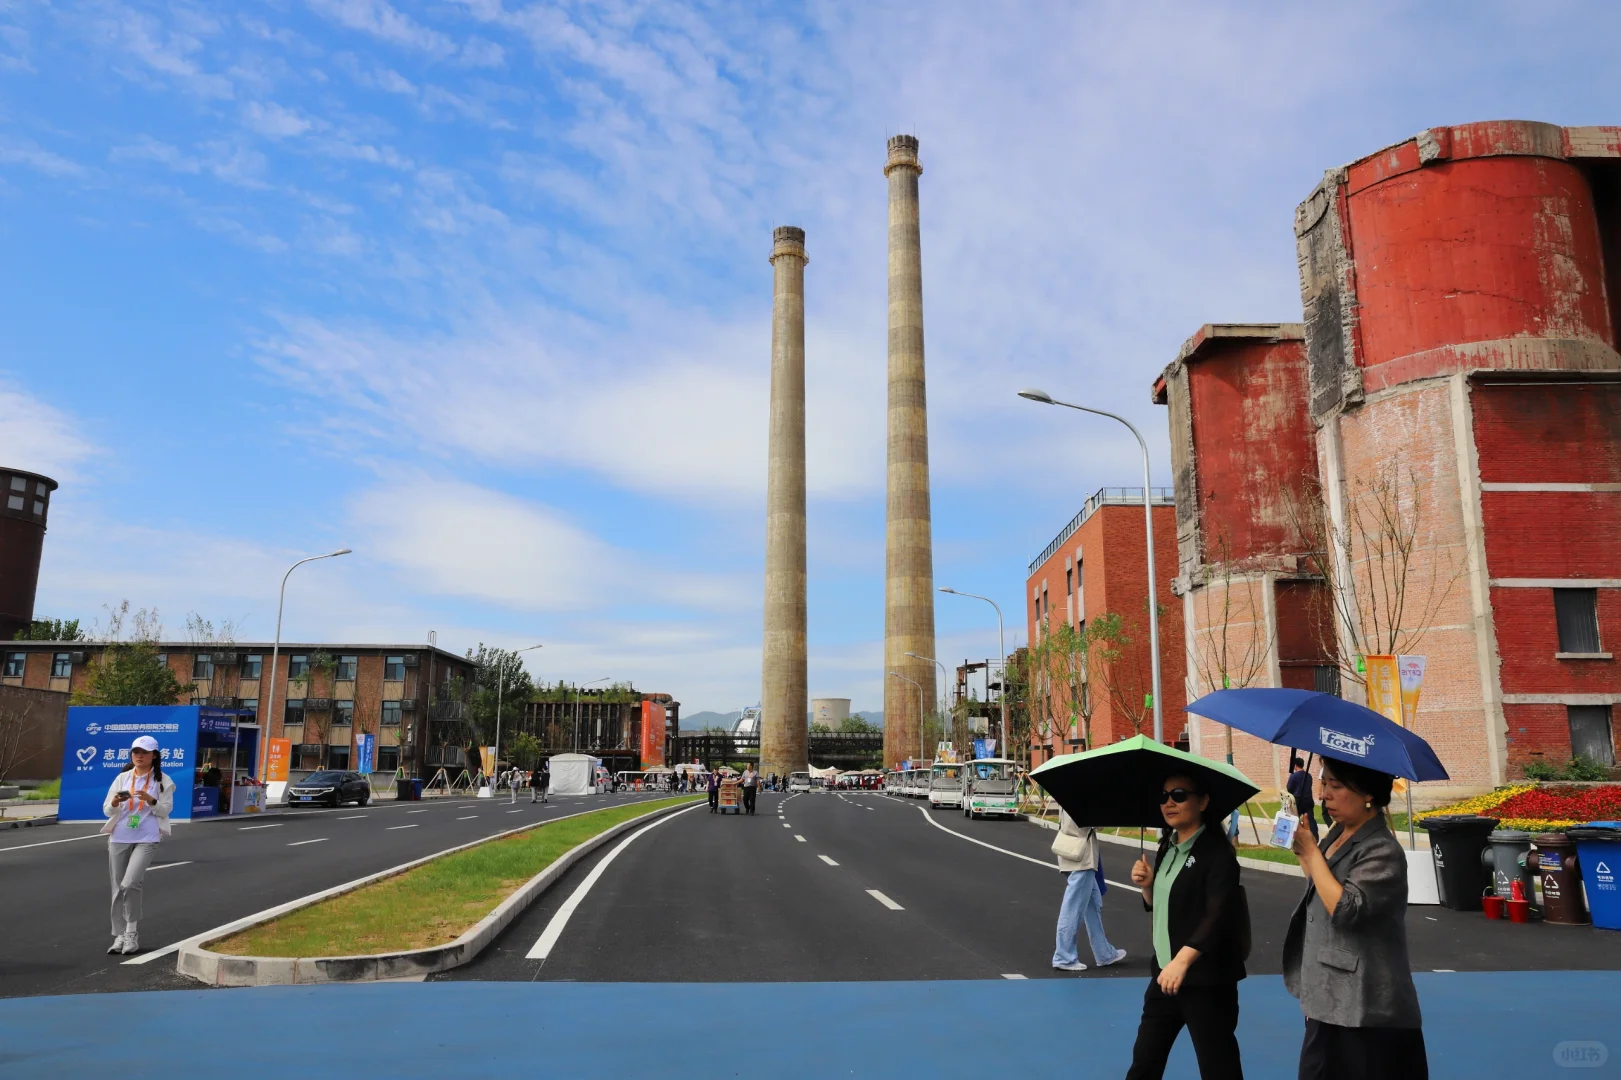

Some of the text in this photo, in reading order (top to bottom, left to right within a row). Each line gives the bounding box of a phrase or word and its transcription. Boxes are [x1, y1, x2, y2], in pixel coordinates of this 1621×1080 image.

[103, 748, 184, 760] 志愿务站
[160, 760, 183, 768] Station
